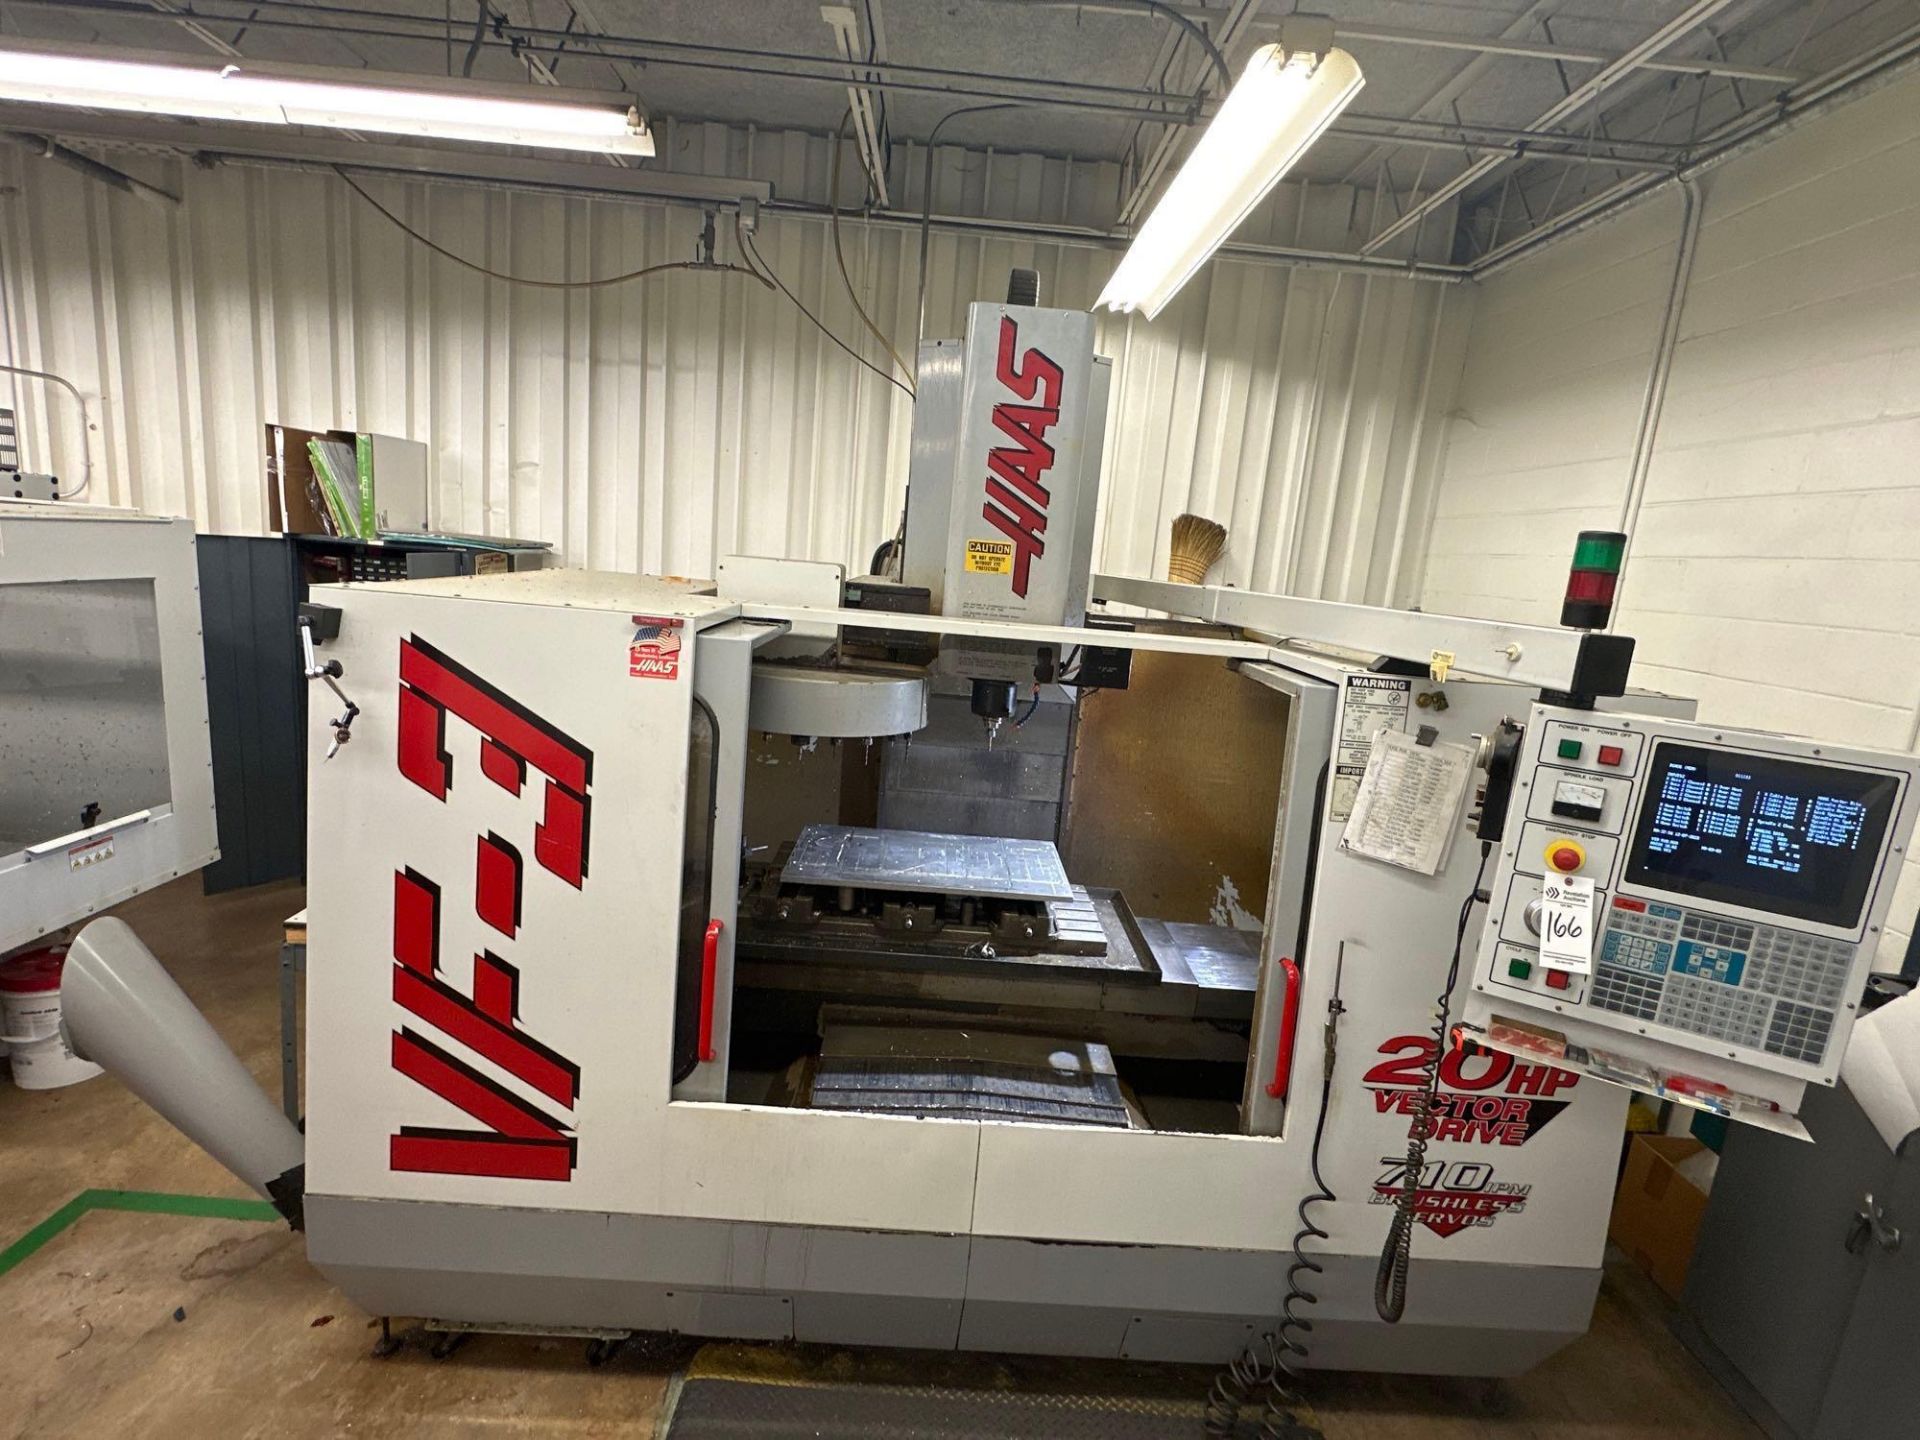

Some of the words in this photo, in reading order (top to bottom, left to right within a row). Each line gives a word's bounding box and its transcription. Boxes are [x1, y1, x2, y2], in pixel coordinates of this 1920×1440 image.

[983, 314, 1063, 599] HAAS
[969, 542, 1011, 554] CAUTION
[631, 659, 678, 673] HAAS
[1352, 677, 1406, 690] WARNING
[390, 632, 593, 1182] VF-3
[1547, 910, 1582, 942] 166
[1374, 1089, 1532, 1122] VECTOR
[1408, 1117, 1530, 1147] DRIVE
[1409, 1211, 1497, 1227] ERVOS
